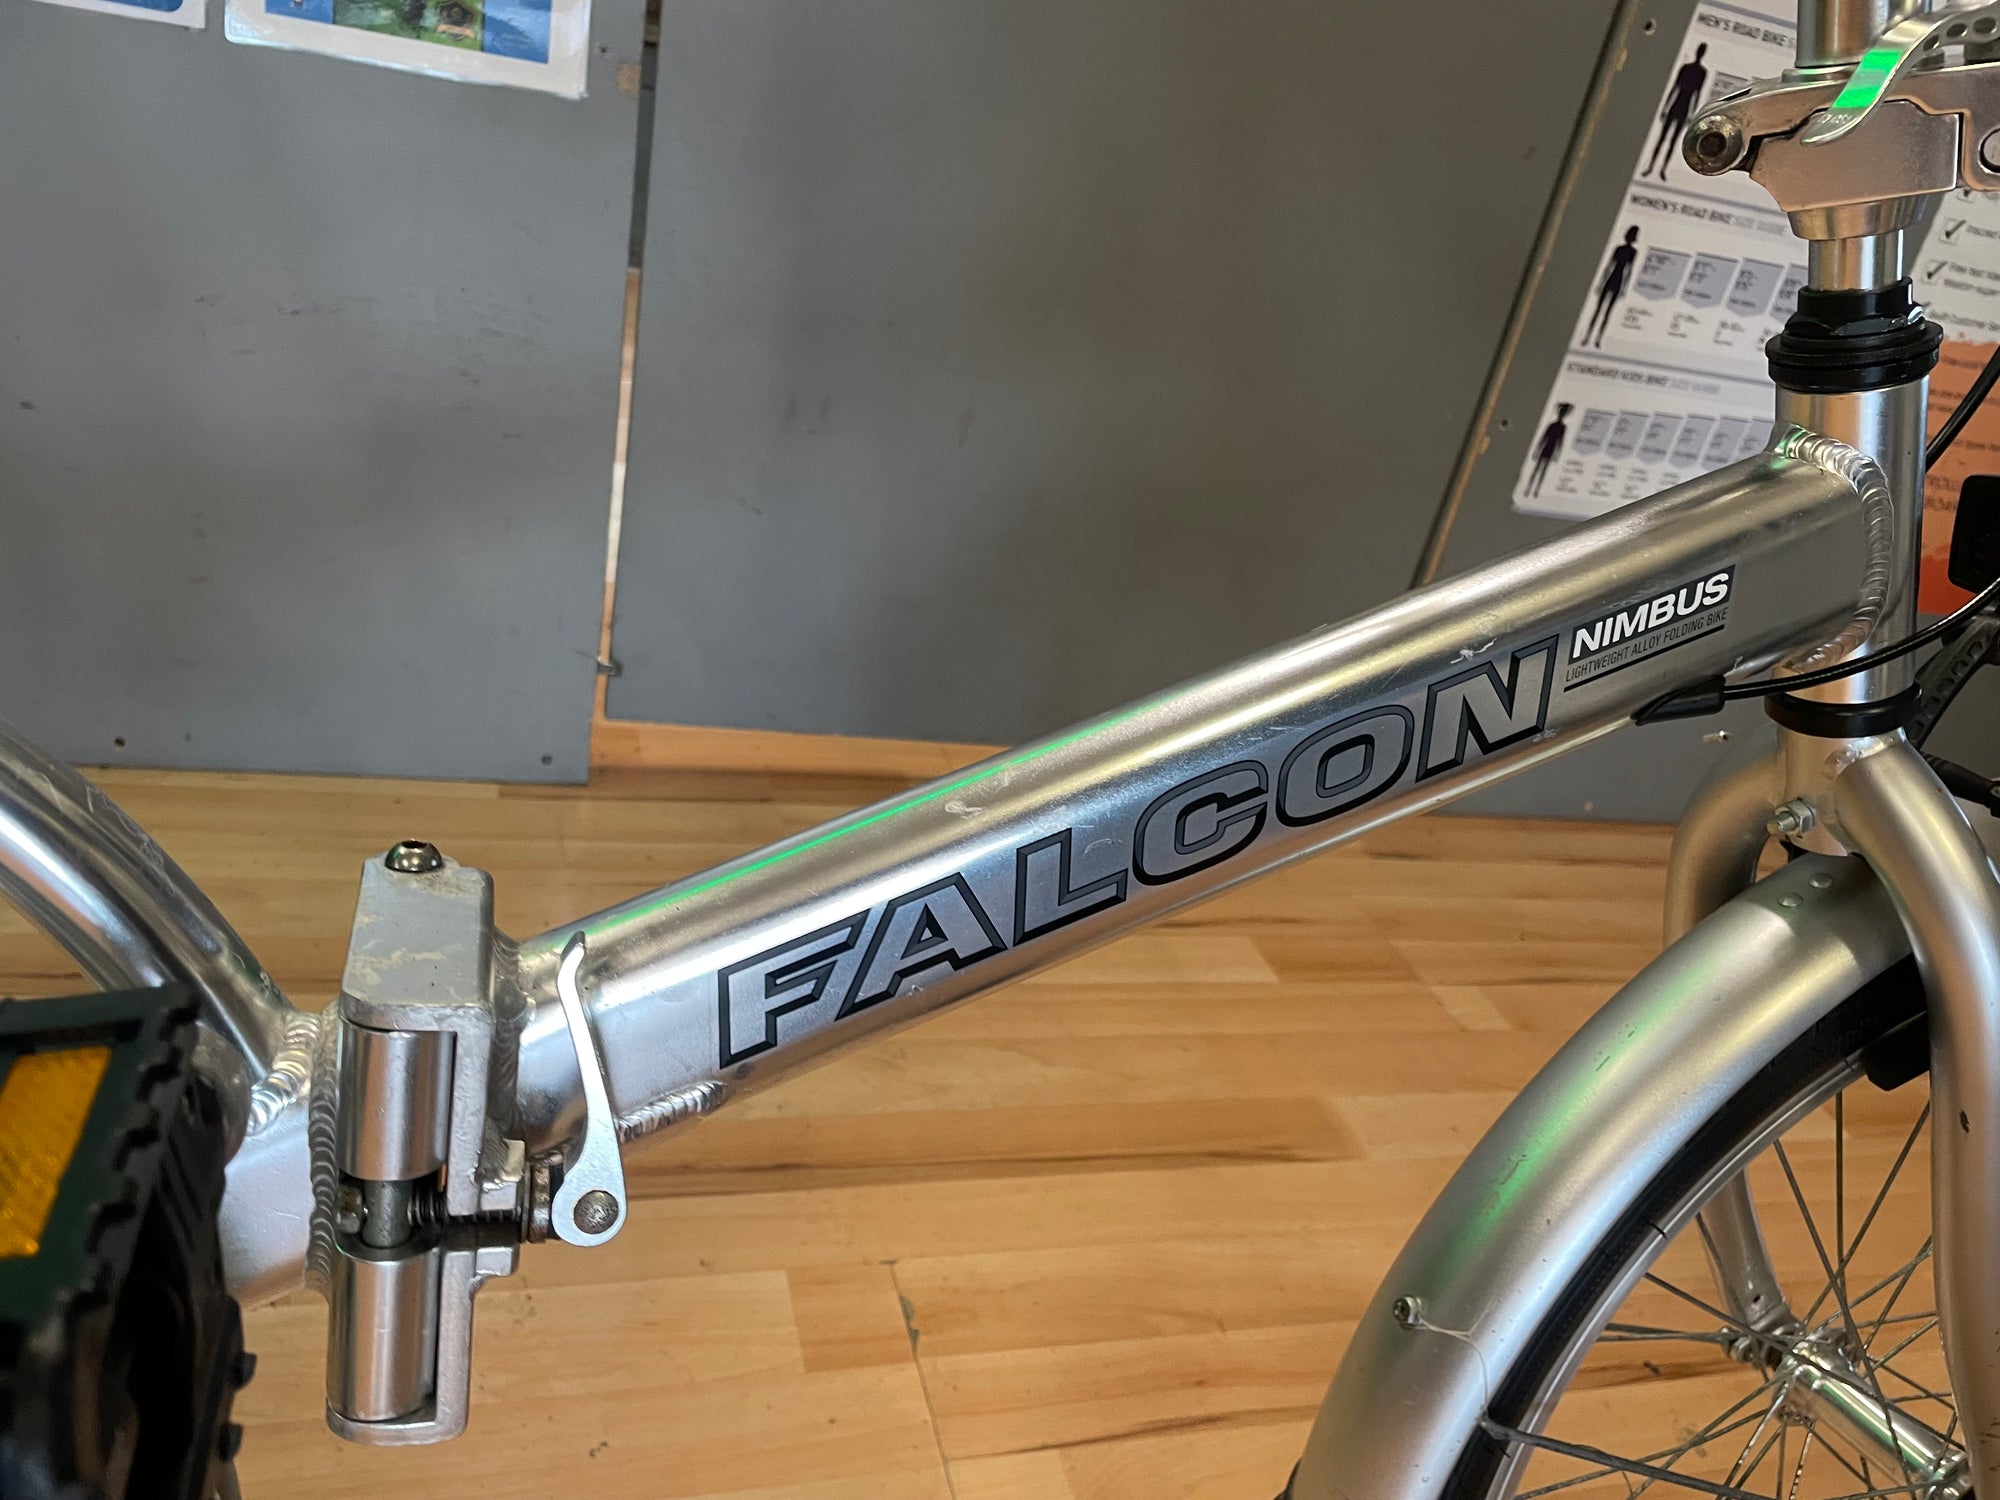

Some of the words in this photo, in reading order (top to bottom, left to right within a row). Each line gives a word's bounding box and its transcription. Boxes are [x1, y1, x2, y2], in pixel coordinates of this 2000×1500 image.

[1697, 12, 1730, 31] MEN'S
[1732, 22, 1761, 39] ROAD
[1762, 29, 1788, 46] BIKE
[1631, 194, 1678, 214] WOMEN'S
[1681, 204, 1709, 220] ROAD
[1709, 210, 1733, 226] BIKE
[1566, 646, 1632, 683] LIGHTWEIGHT
[1630, 633, 1662, 657] ALLOY
[1663, 617, 1705, 644] FOLDING
[1706, 606, 1729, 627] BIKE
[1572, 573, 1729, 659] NIMBUS
[717, 633, 1559, 1069] FALCON
